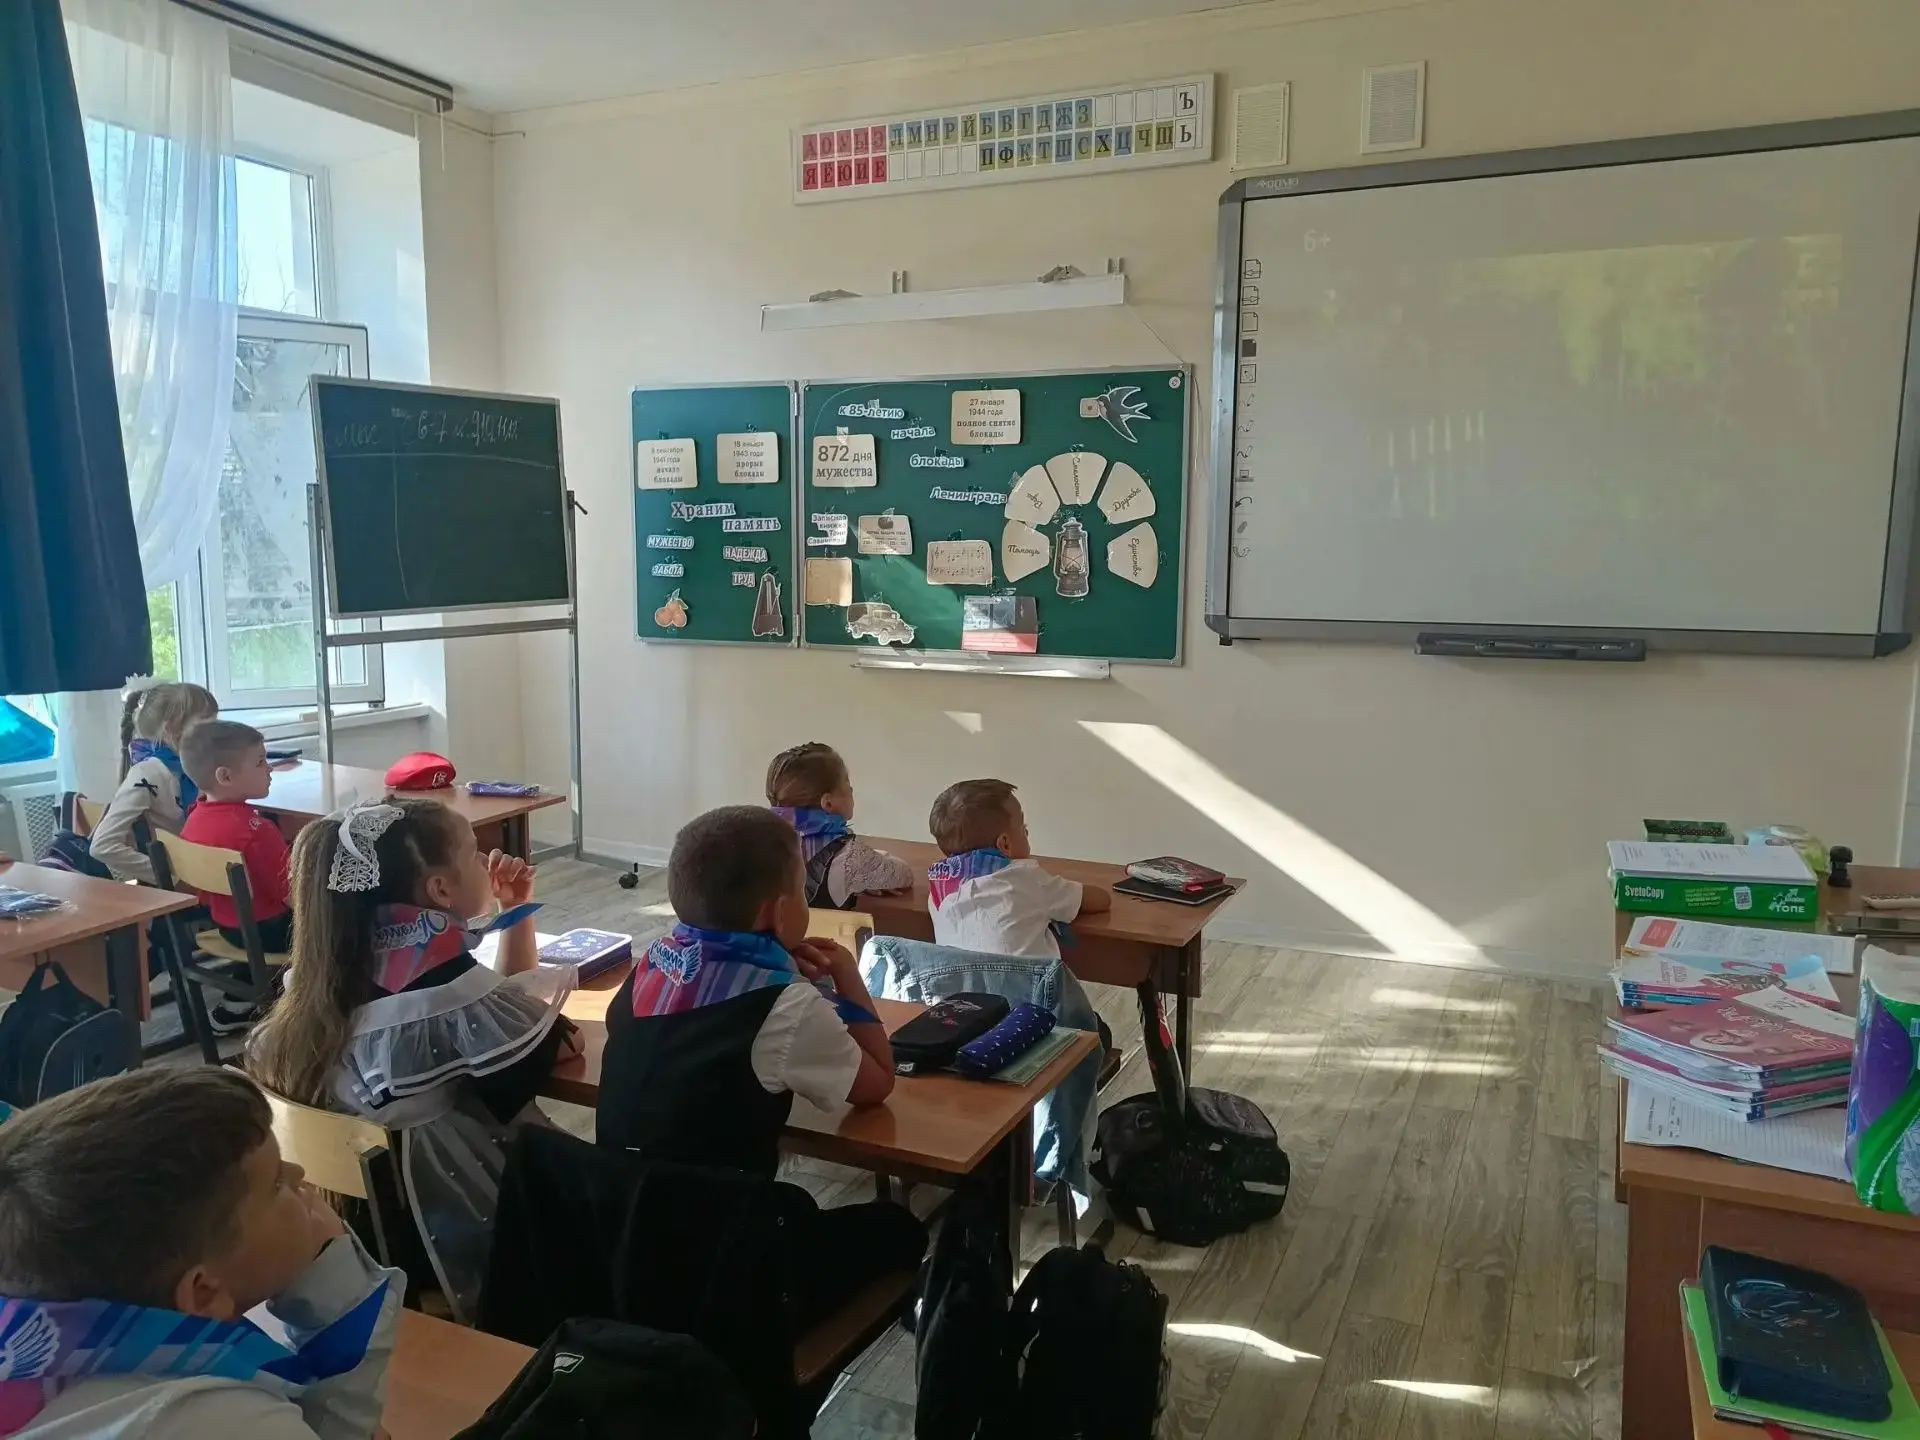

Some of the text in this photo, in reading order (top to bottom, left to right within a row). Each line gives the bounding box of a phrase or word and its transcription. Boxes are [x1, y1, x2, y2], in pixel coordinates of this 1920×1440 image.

[1304, 229, 1331, 252] 6+
[839, 404, 904, 418] к 85-летию
[892, 427, 936, 438] начала
[969, 430, 1004, 438] блокады
[818, 445, 872, 464] 872 дня
[911, 454, 964, 467] блокады
[816, 466, 873, 480] мужества
[931, 487, 1007, 504] Ленинграда
[1112, 487, 1142, 512] Дружба
[672, 502, 736, 520] Храним
[724, 518, 781, 531] память
[648, 536, 694, 548] МУЖЕСТВО
[725, 547, 767, 561] НАДЕЖДА
[652, 565, 683, 576] ЗАБОТА
[733, 572, 754, 586] ТРУД
[1625, 884, 1665, 900] SvetoCopy
